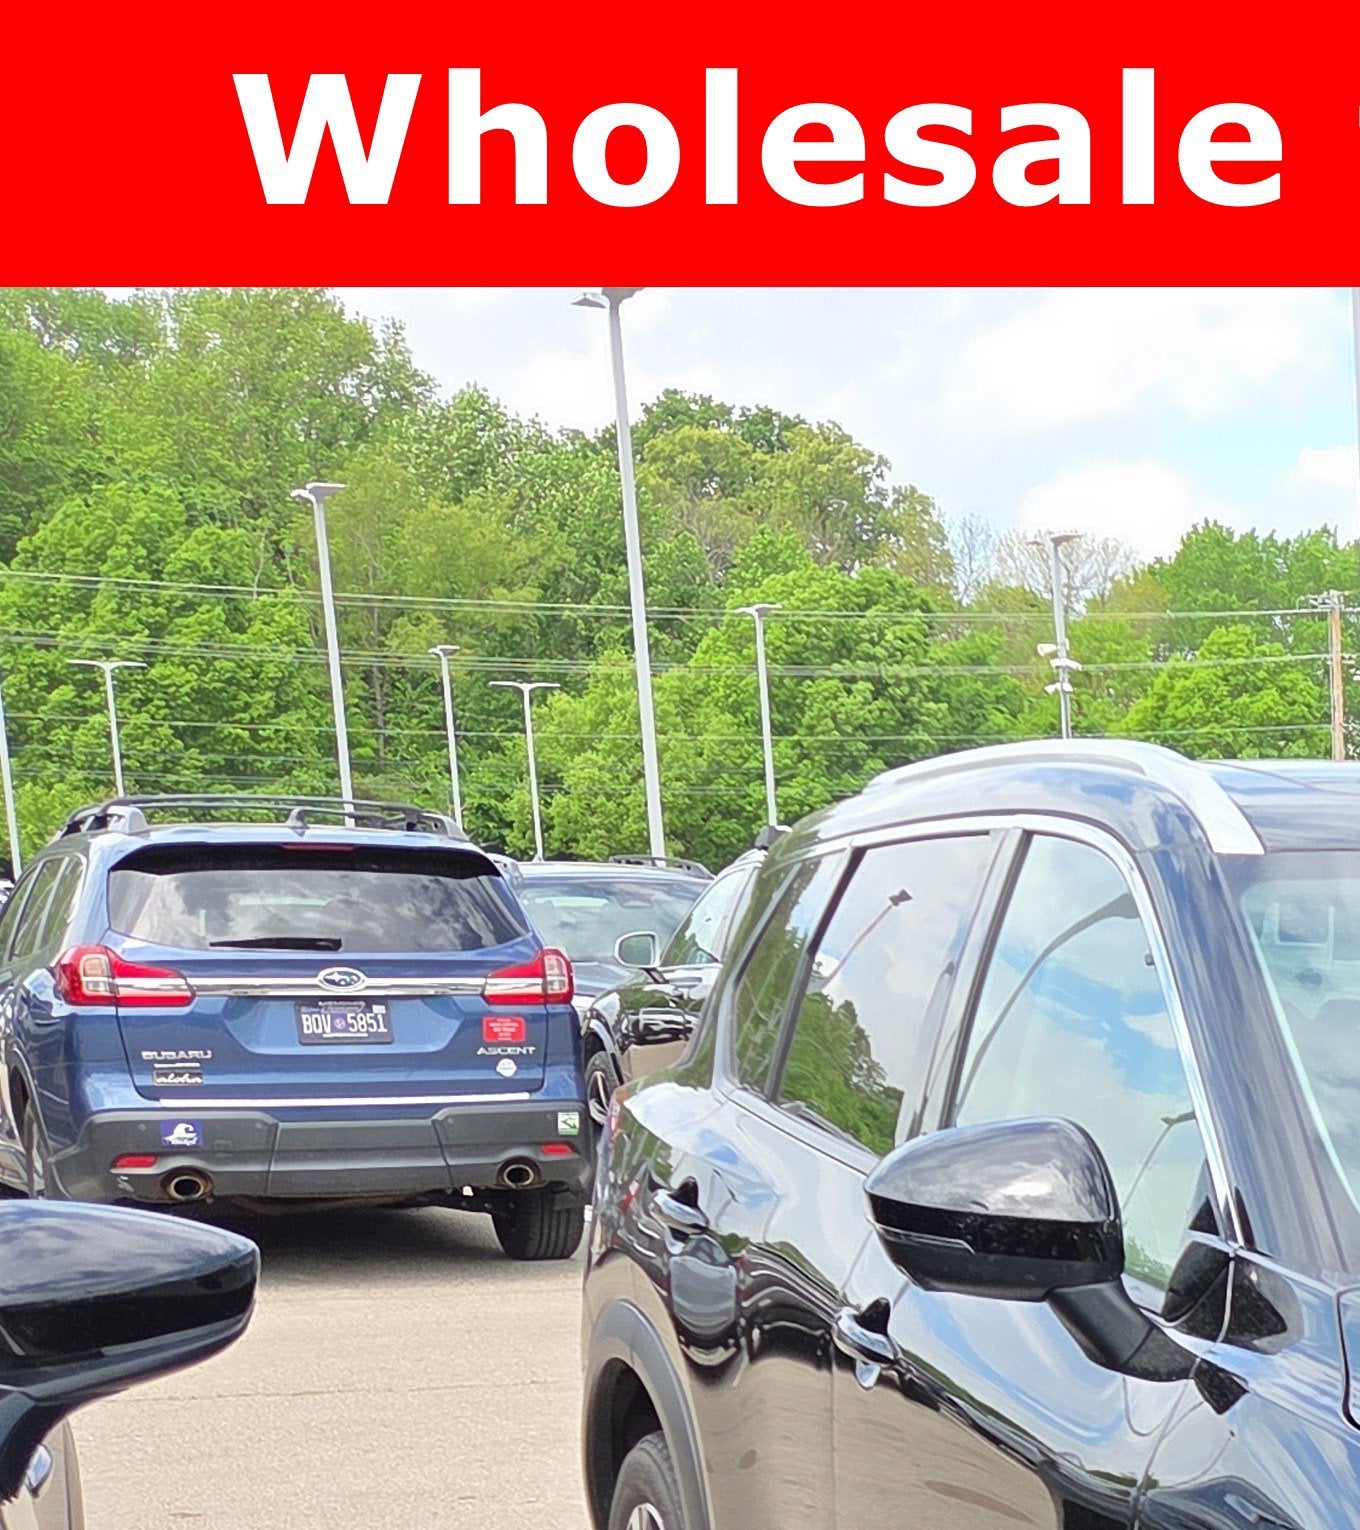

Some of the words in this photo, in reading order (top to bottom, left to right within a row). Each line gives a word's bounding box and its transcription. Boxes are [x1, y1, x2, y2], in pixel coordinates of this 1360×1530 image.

[347, 1012, 388, 1032] 5851
[141, 1049, 212, 1060] SUBARU
[476, 1046, 536, 1056] ASCENT
